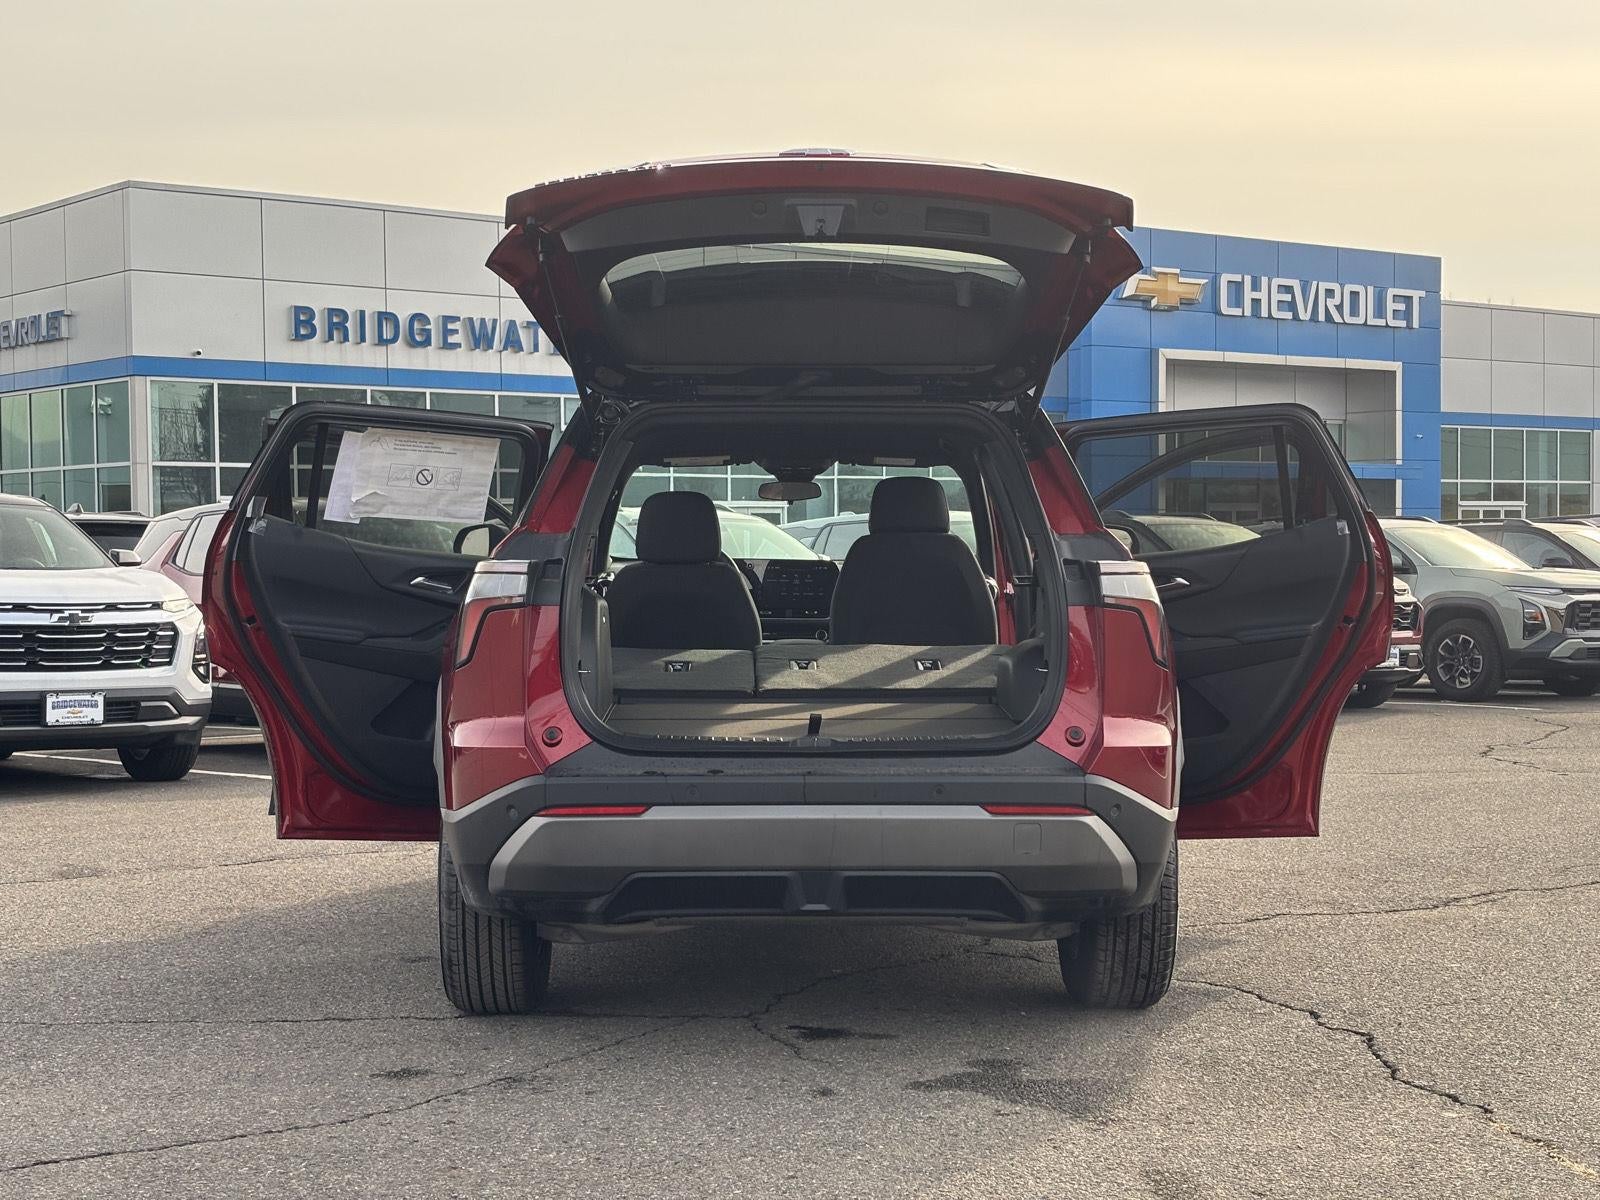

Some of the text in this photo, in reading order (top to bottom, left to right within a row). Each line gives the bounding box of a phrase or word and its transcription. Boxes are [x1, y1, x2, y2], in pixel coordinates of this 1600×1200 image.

[1219, 273, 1426, 329] CHEVROLET
[290, 304, 560, 356] BRIDGEWAT
[52, 699, 98, 710] BRIDGEWATER
